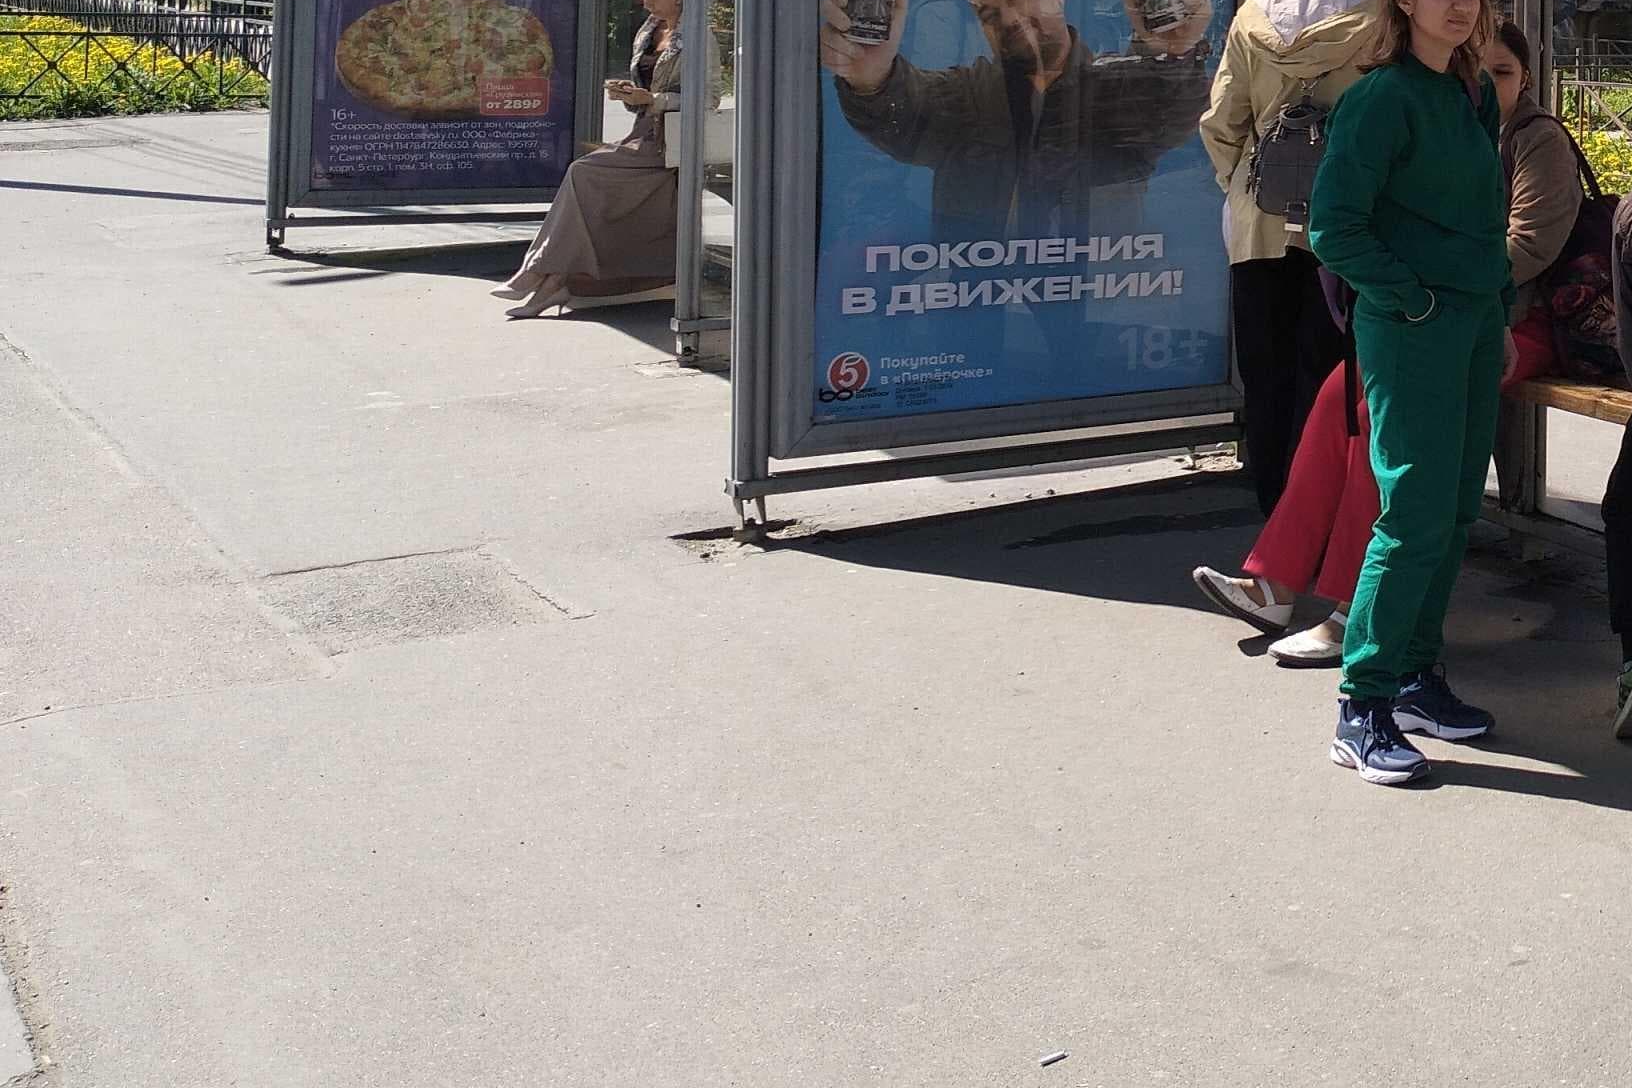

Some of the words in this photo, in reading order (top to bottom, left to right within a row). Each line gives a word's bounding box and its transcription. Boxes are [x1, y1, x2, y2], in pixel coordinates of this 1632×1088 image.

[331, 109, 357, 120] 16+
[865, 233, 1164, 273] ПОКОЛЕНИЯ
[842, 286, 877, 314] В
[886, 269, 1183, 316] ДВИЖЕНИИ!
[880, 352, 966, 370] Покупайте
[1117, 325, 1208, 371] 18+
[880, 375, 889, 385] в
